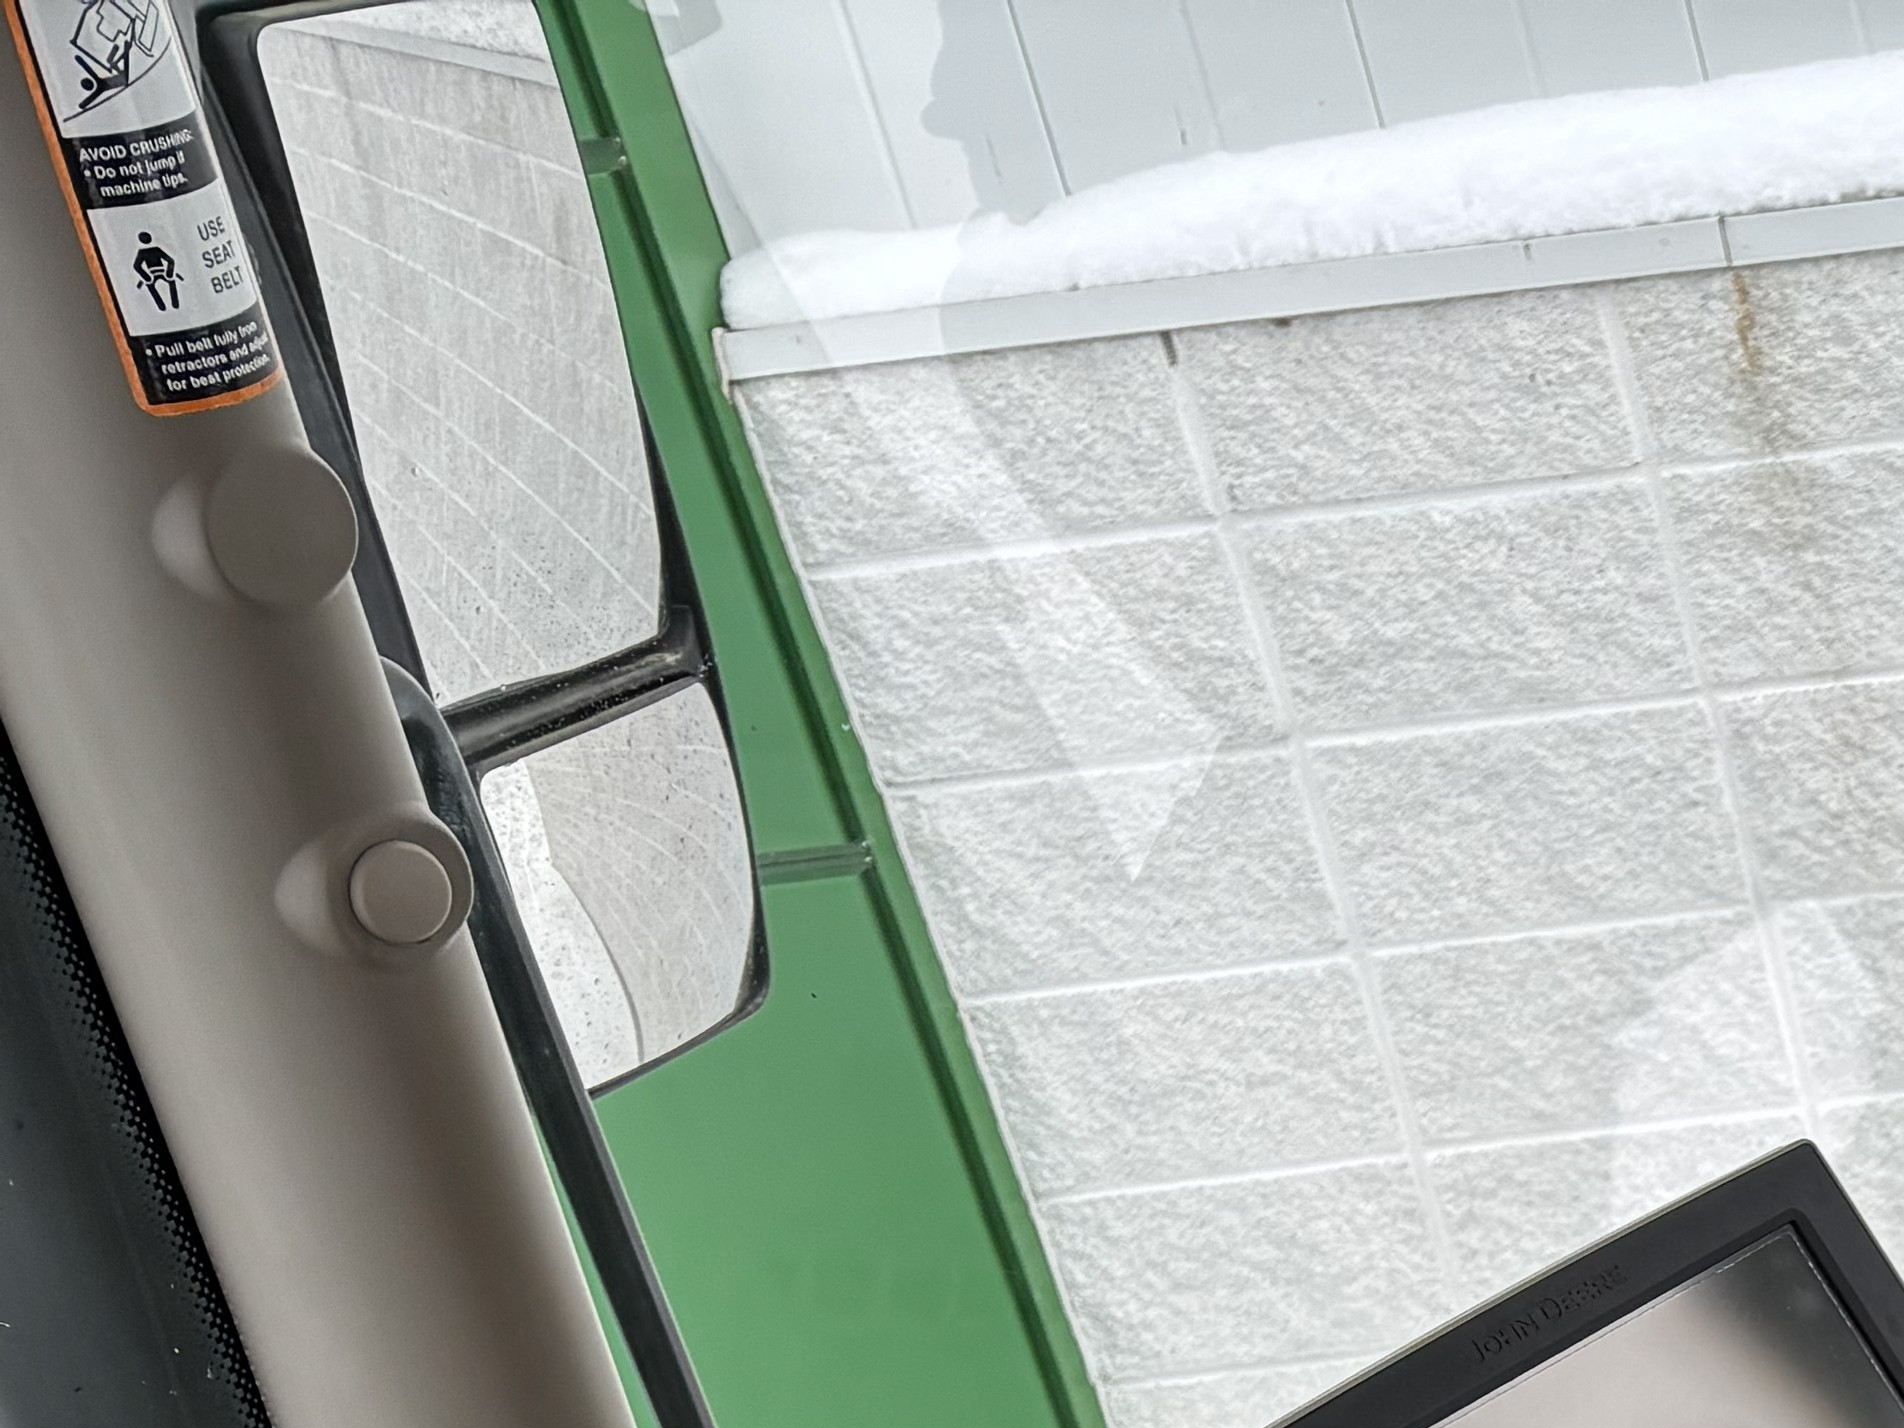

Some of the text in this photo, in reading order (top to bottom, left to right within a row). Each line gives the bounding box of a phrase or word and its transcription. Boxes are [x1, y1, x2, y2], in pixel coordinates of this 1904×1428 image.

[79, 128, 194, 163] AVOID CRUSHING:
[94, 165, 116, 179] Do
[119, 161, 144, 177] not
[145, 154, 176, 175] jump
[100, 178, 161, 198] machine
[196, 215, 225, 241] USE
[202, 240, 235, 269] SEAT
[211, 265, 243, 293] BELT
[154, 343, 184, 358] Pull
[213, 328, 238, 347] fully
[161, 352, 228, 375] retractors
[166, 379, 188, 392] for
[189, 371, 222, 389] best
